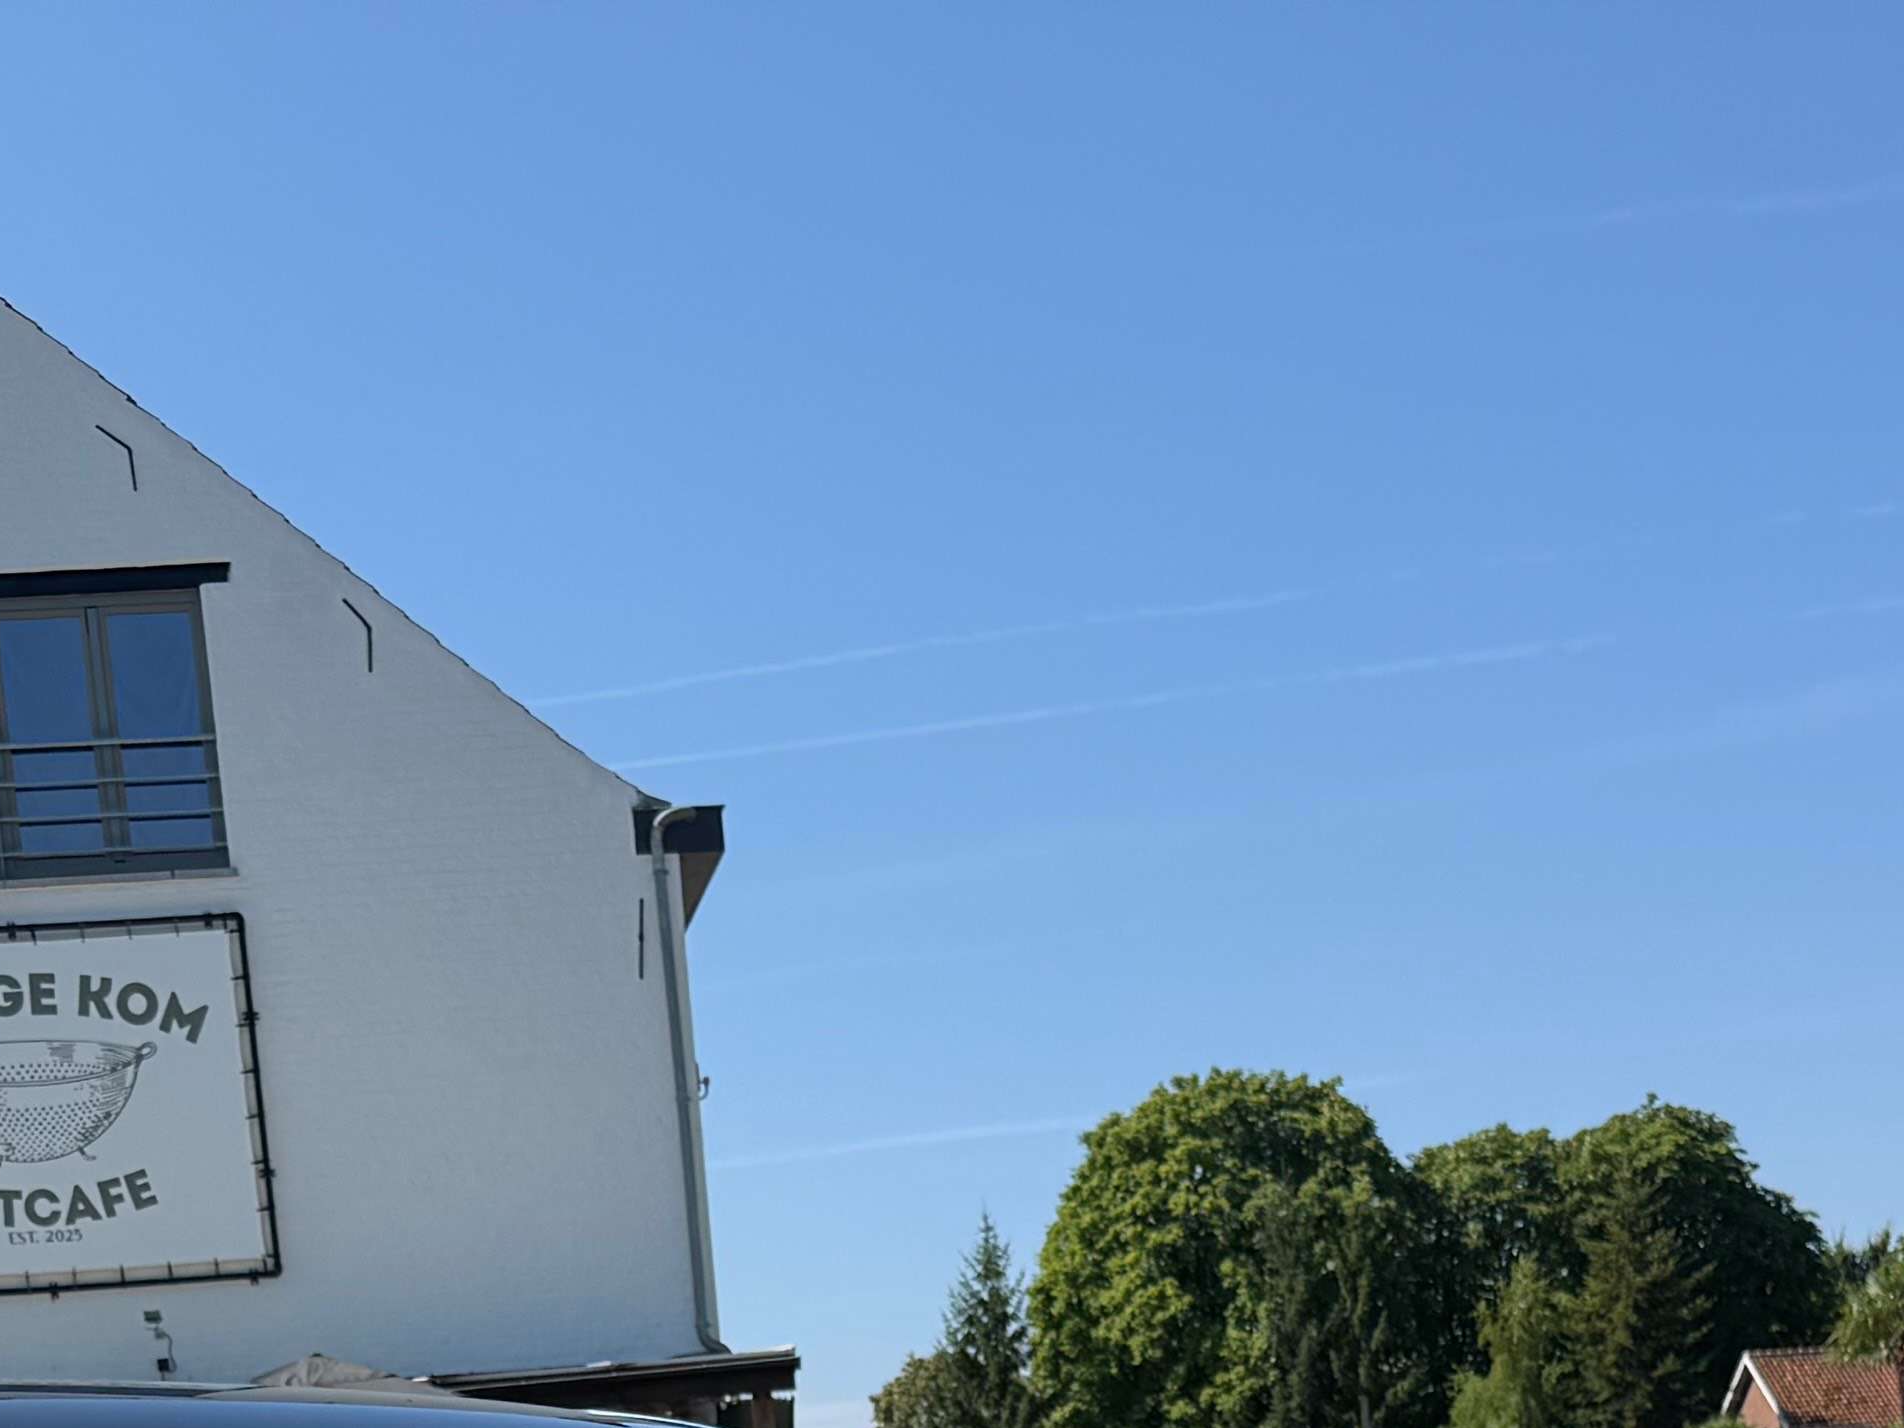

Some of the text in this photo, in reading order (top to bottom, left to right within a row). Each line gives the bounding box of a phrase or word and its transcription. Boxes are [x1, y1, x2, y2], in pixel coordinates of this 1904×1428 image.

[78, 975, 209, 1044] KOM
[8, 1228, 83, 1245] EST. 2025
